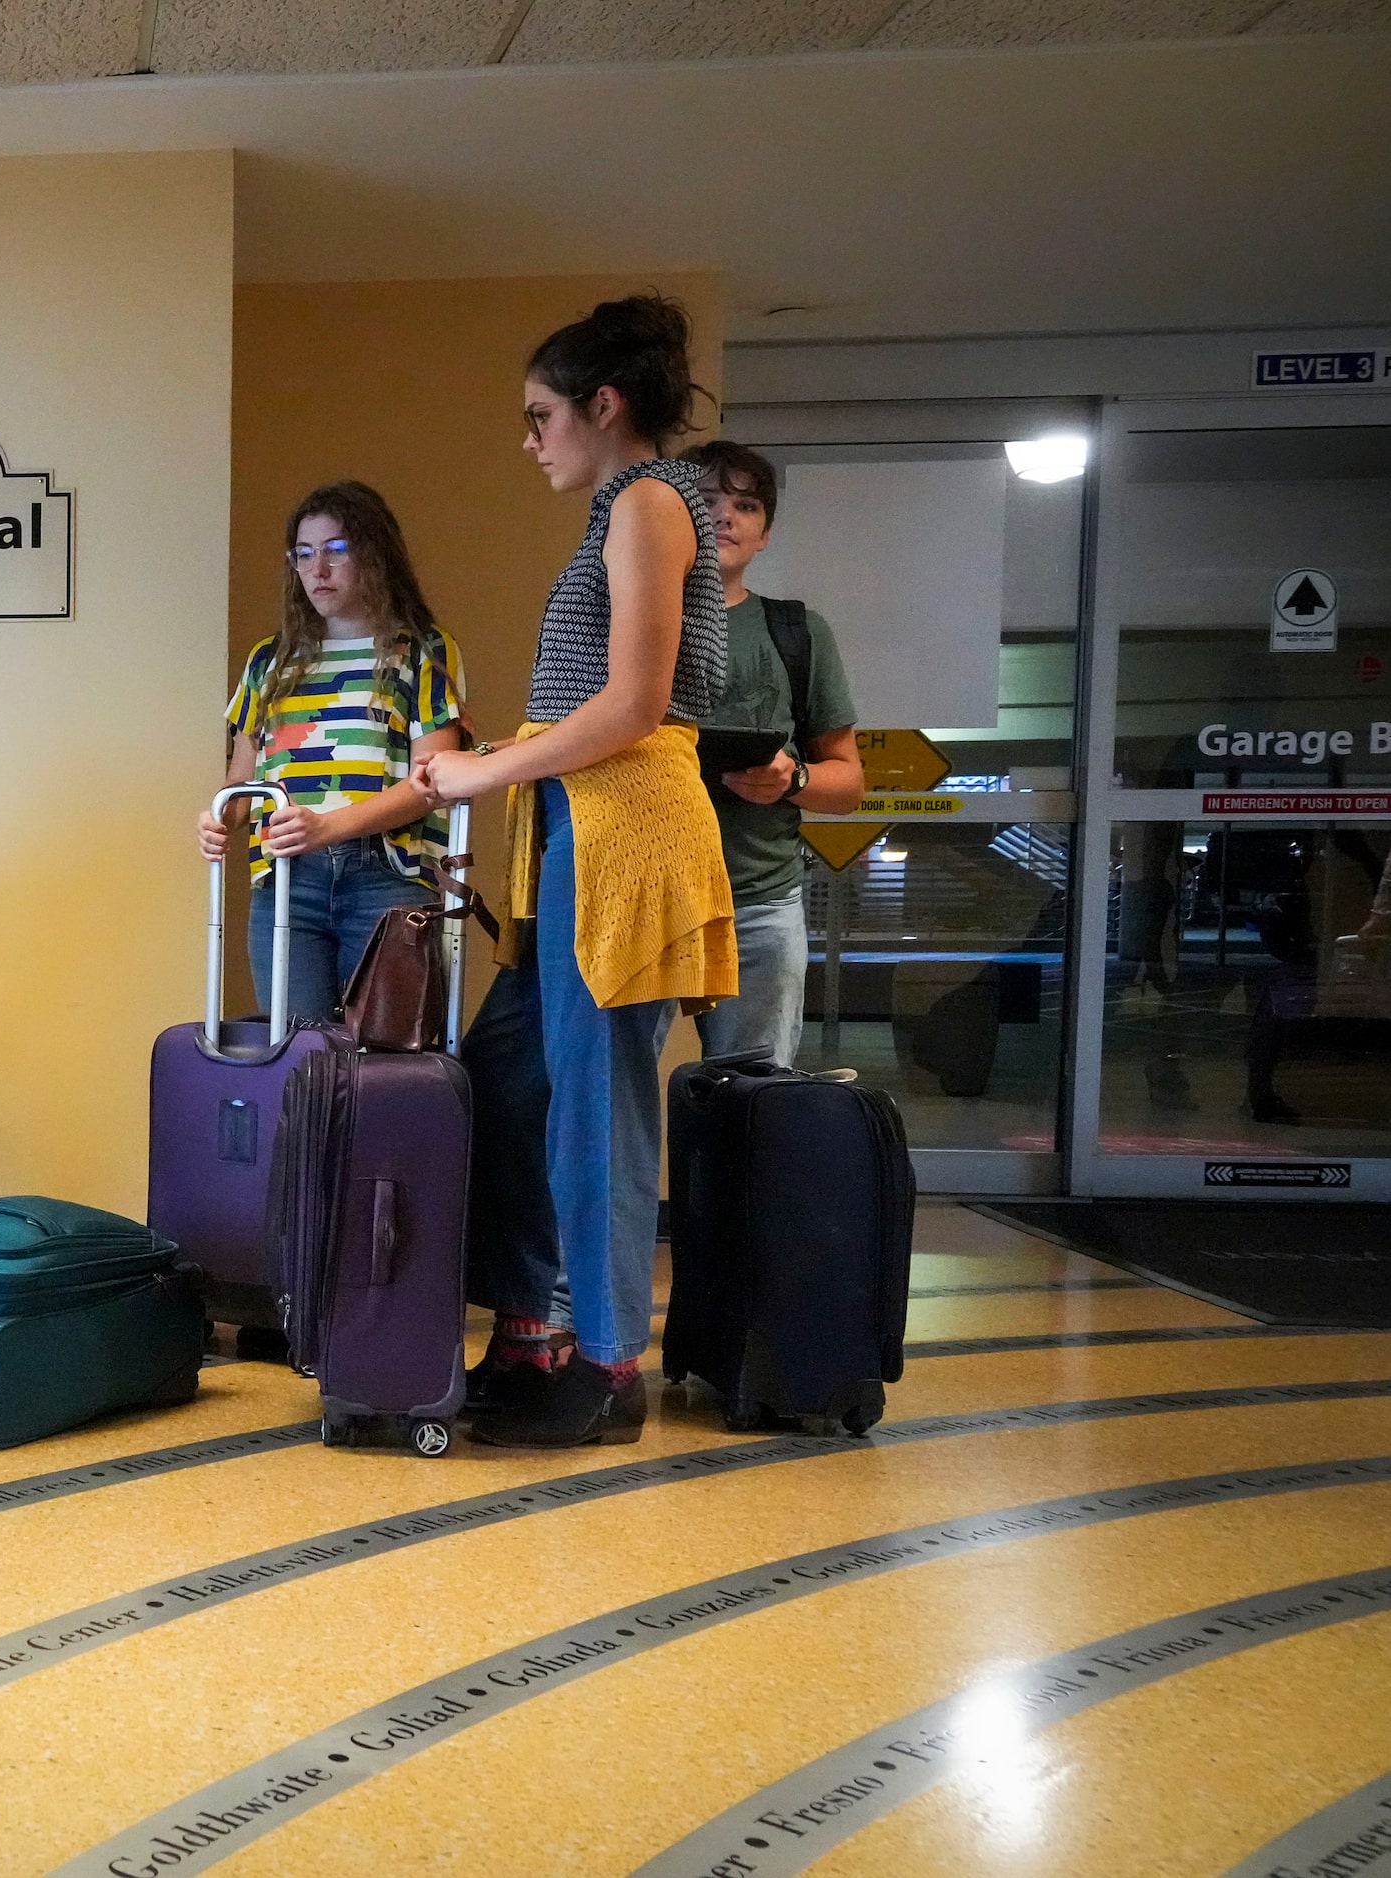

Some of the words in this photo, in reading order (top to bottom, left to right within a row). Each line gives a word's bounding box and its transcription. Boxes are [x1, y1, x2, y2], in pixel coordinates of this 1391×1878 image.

[1263, 357, 1349, 381] LEVEL
[1356, 356, 1372, 380] 3
[1197, 723, 1354, 765] Garage
[1369, 721, 1391, 754] B
[861, 800, 885, 811] DOOR
[894, 800, 922, 811] STAND
[924, 800, 952, 811] CLEAR
[1208, 797, 1221, 810] IN
[1223, 797, 1297, 810] EMERGENCY
[1299, 797, 1333, 810] PUSH
[1335, 797, 1352, 810] TO
[1355, 797, 1388, 810] OPEN
[112, 1442, 245, 1474] Hillsboro
[26, 1607, 144, 1653] Center
[163, 1541, 354, 1603] Hallettsville
[370, 1497, 527, 1544] Hallsburg
[539, 1465, 667, 1499] Hallsville
[689, 1448, 791, 1468] Haltom
[877, 1416, 1004, 1438] Hamilton
[108, 1767, 333, 1878] Goldthwaite
[349, 1695, 474, 1754] Goliad
[487, 1637, 619, 1691] Golinda
[634, 1578, 779, 1632] Gonzales
[790, 1540, 923, 1583] Goodlow
[940, 1504, 1082, 1545] Goodrich
[753, 1775, 885, 1838] Fresno
[1091, 1634, 1212, 1673] Friona
[1216, 1602, 1329, 1633] Frisco
